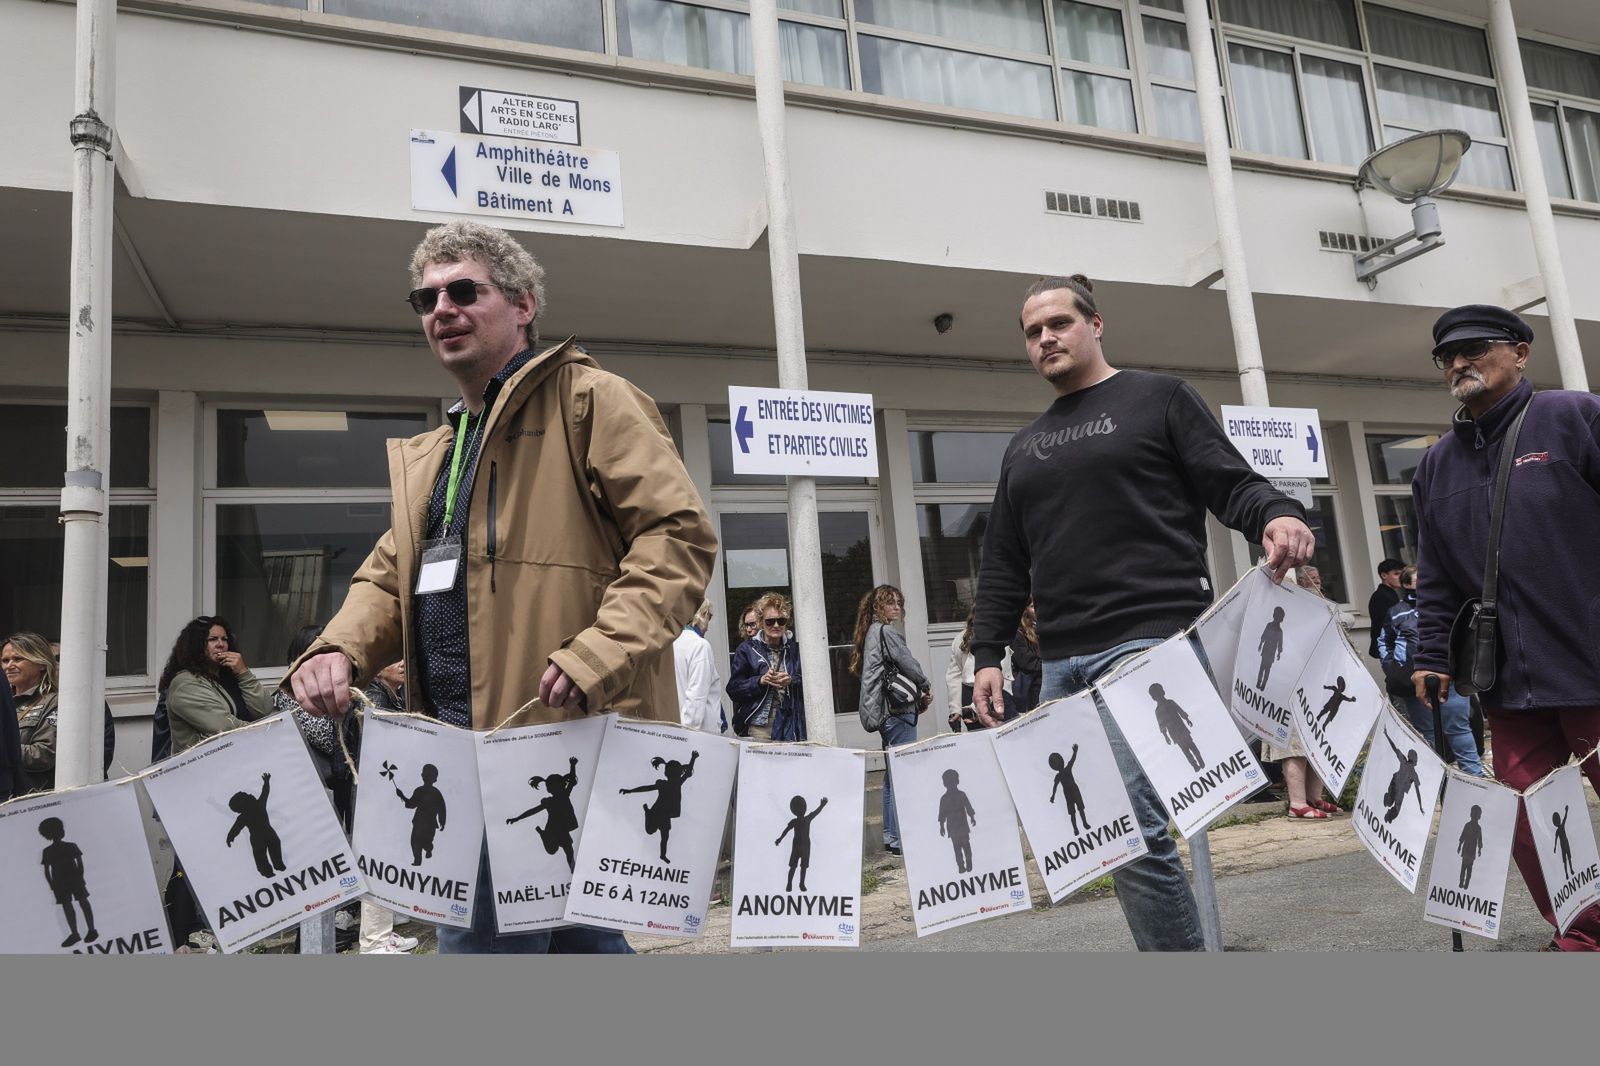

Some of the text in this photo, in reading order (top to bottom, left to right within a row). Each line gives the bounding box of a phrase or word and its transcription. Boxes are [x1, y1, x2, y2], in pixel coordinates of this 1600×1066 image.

[491, 106, 576, 123] ARTS EN SCENES
[503, 98, 557, 111] ALTER EGO
[500, 116, 530, 127] RADIO
[503, 127, 528, 137] ENTRÉE
[476, 142, 588, 169] Amphithéâtre
[497, 166, 611, 193] Ville de Mons
[477, 191, 574, 215] Bâtiment A
[758, 396, 872, 425] ENTRÉE DES VICTIMES
[1022, 412, 1117, 461] Rennais
[1229, 417, 1262, 437] ENTRÉE
[1262, 421, 1293, 438] PRESSE
[768, 434, 868, 458] ET PARTIES CIVILES
[1252, 449, 1284, 466] PUBLIC
[1235, 678, 1292, 728] ANONYME
[1297, 687, 1346, 778] ANONYME
[1171, 750, 1251, 817] ANONYME
[1044, 815, 1135, 876] ANONYME
[1357, 799, 1417, 871] ANONYME
[357, 854, 470, 902] ANONYME
[598, 858, 691, 884] STÉPHANIE
[218, 852, 352, 931] ANONYME
[583, 881, 691, 910] DE 6 À 12ANS
[918, 867, 1022, 911] ANONYME
[1429, 886, 1498, 919] ANONYME
[1554, 864, 1600, 912] ANONYME
[737, 894, 854, 917] ANONYME
